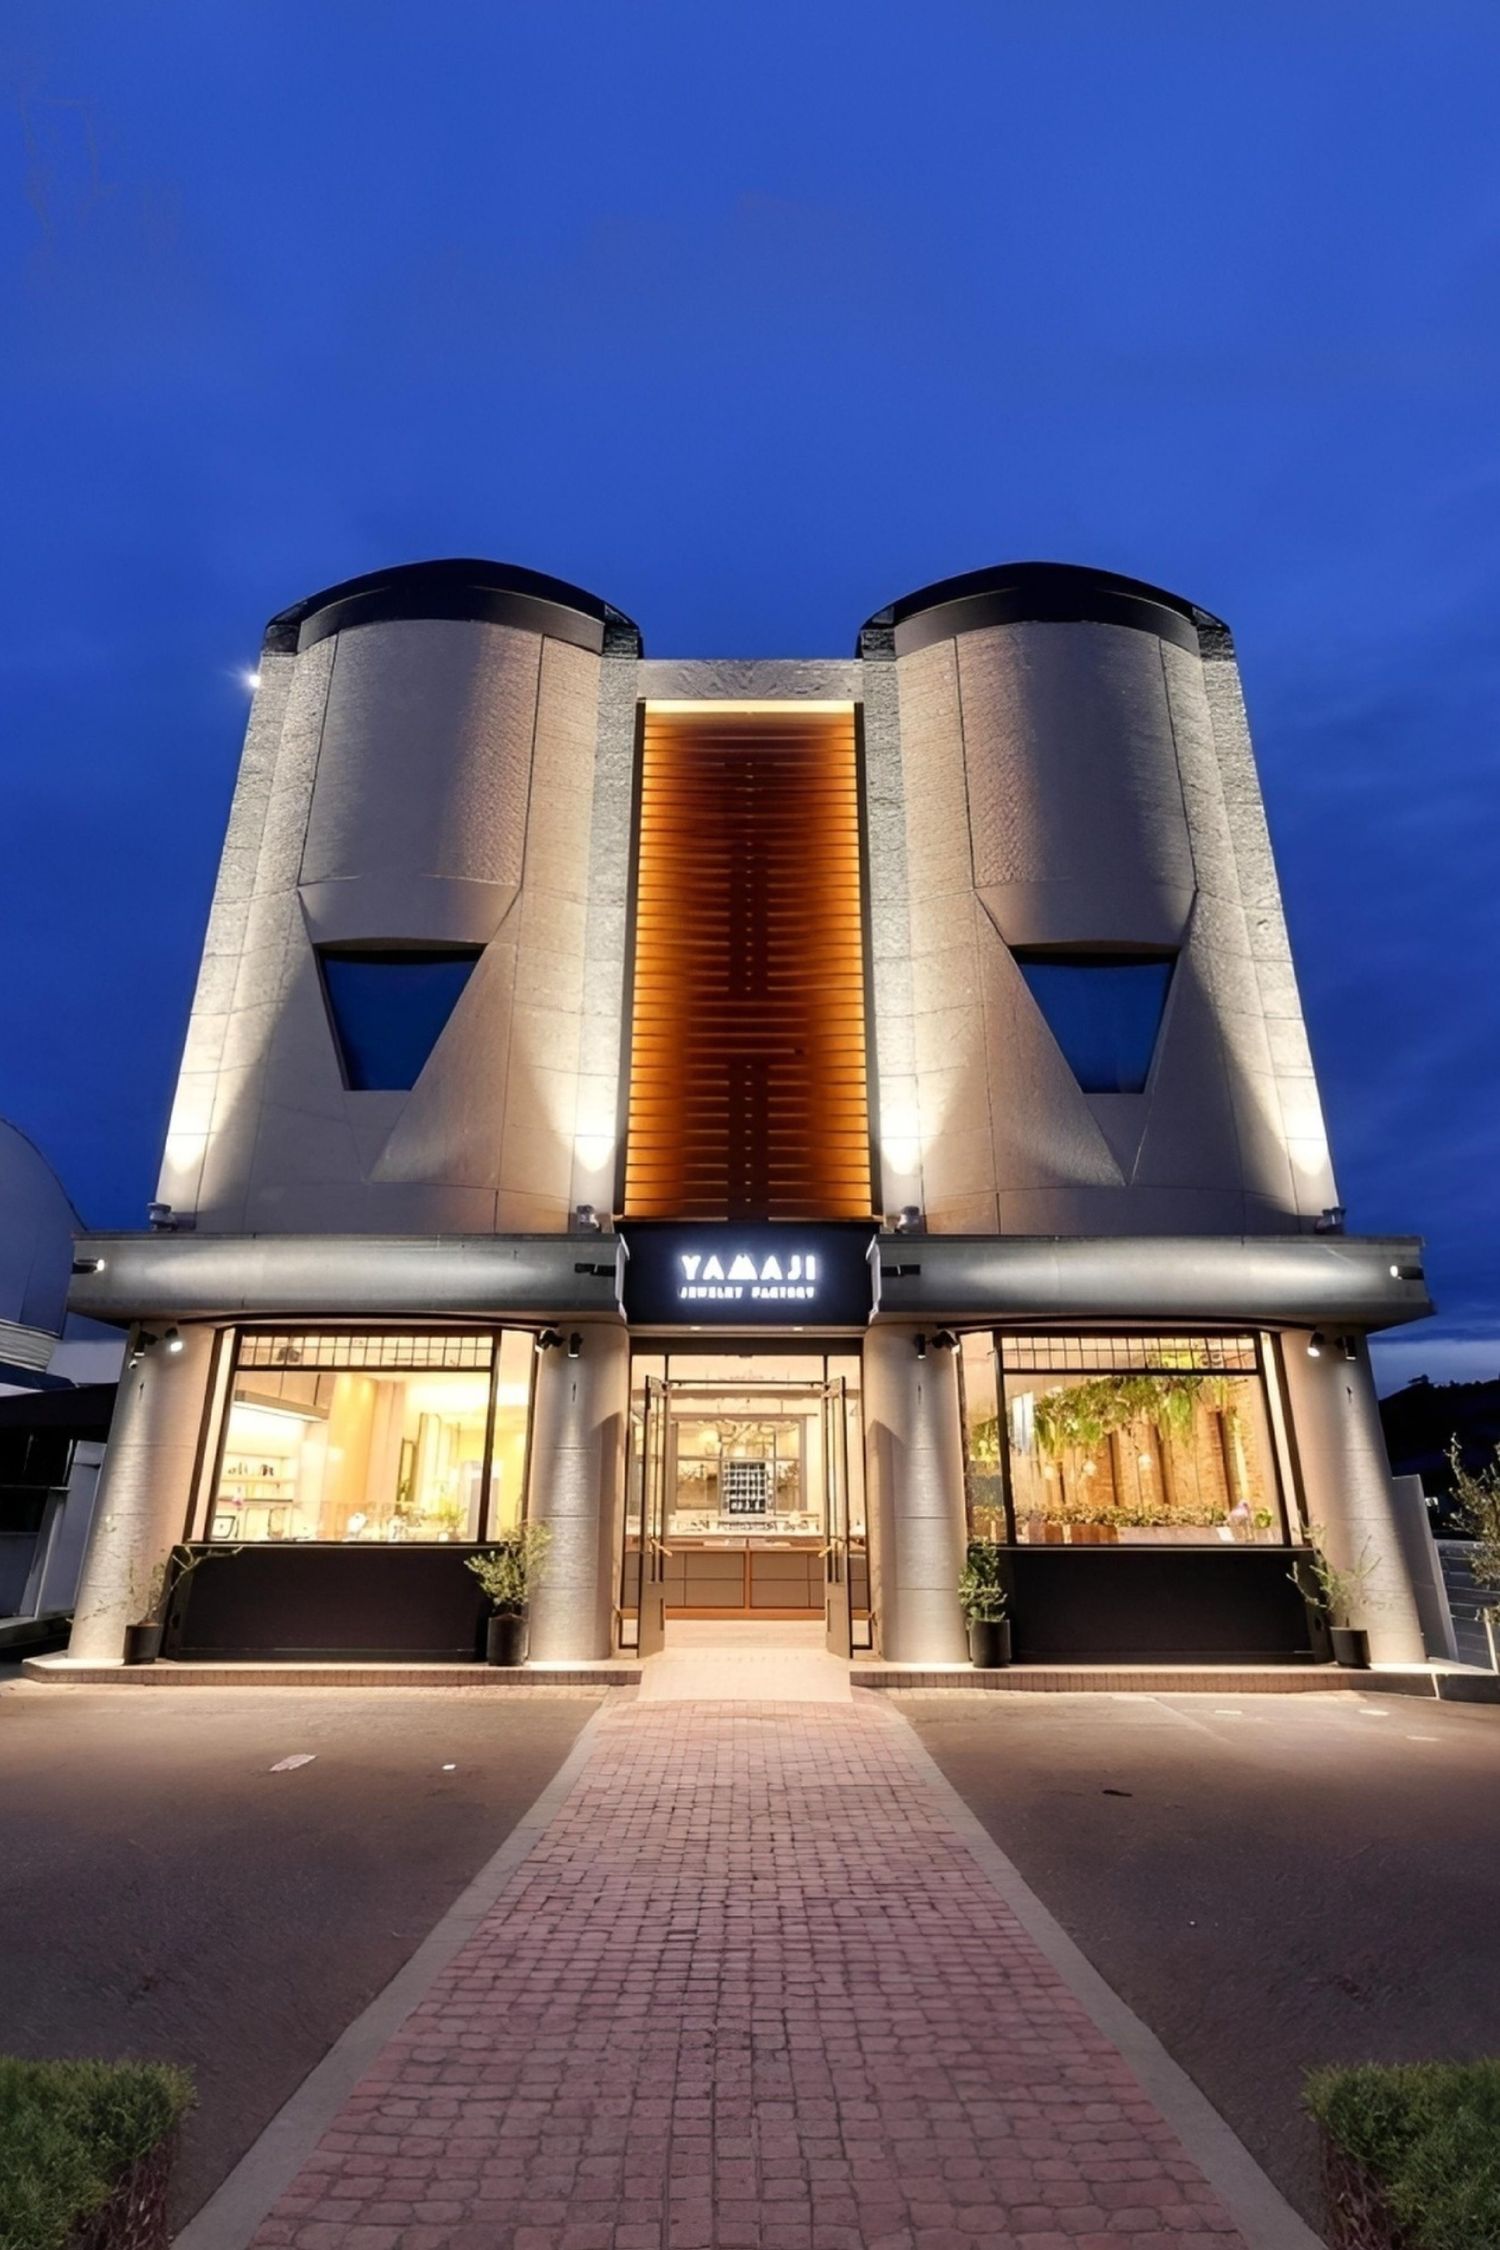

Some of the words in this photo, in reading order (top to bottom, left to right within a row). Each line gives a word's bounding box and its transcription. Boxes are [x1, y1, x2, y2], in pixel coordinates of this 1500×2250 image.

[681, 1254, 817, 1281] YAMAJI
[680, 1286, 743, 1299] JEWELRY
[751, 1286, 815, 1299] FACTORY
